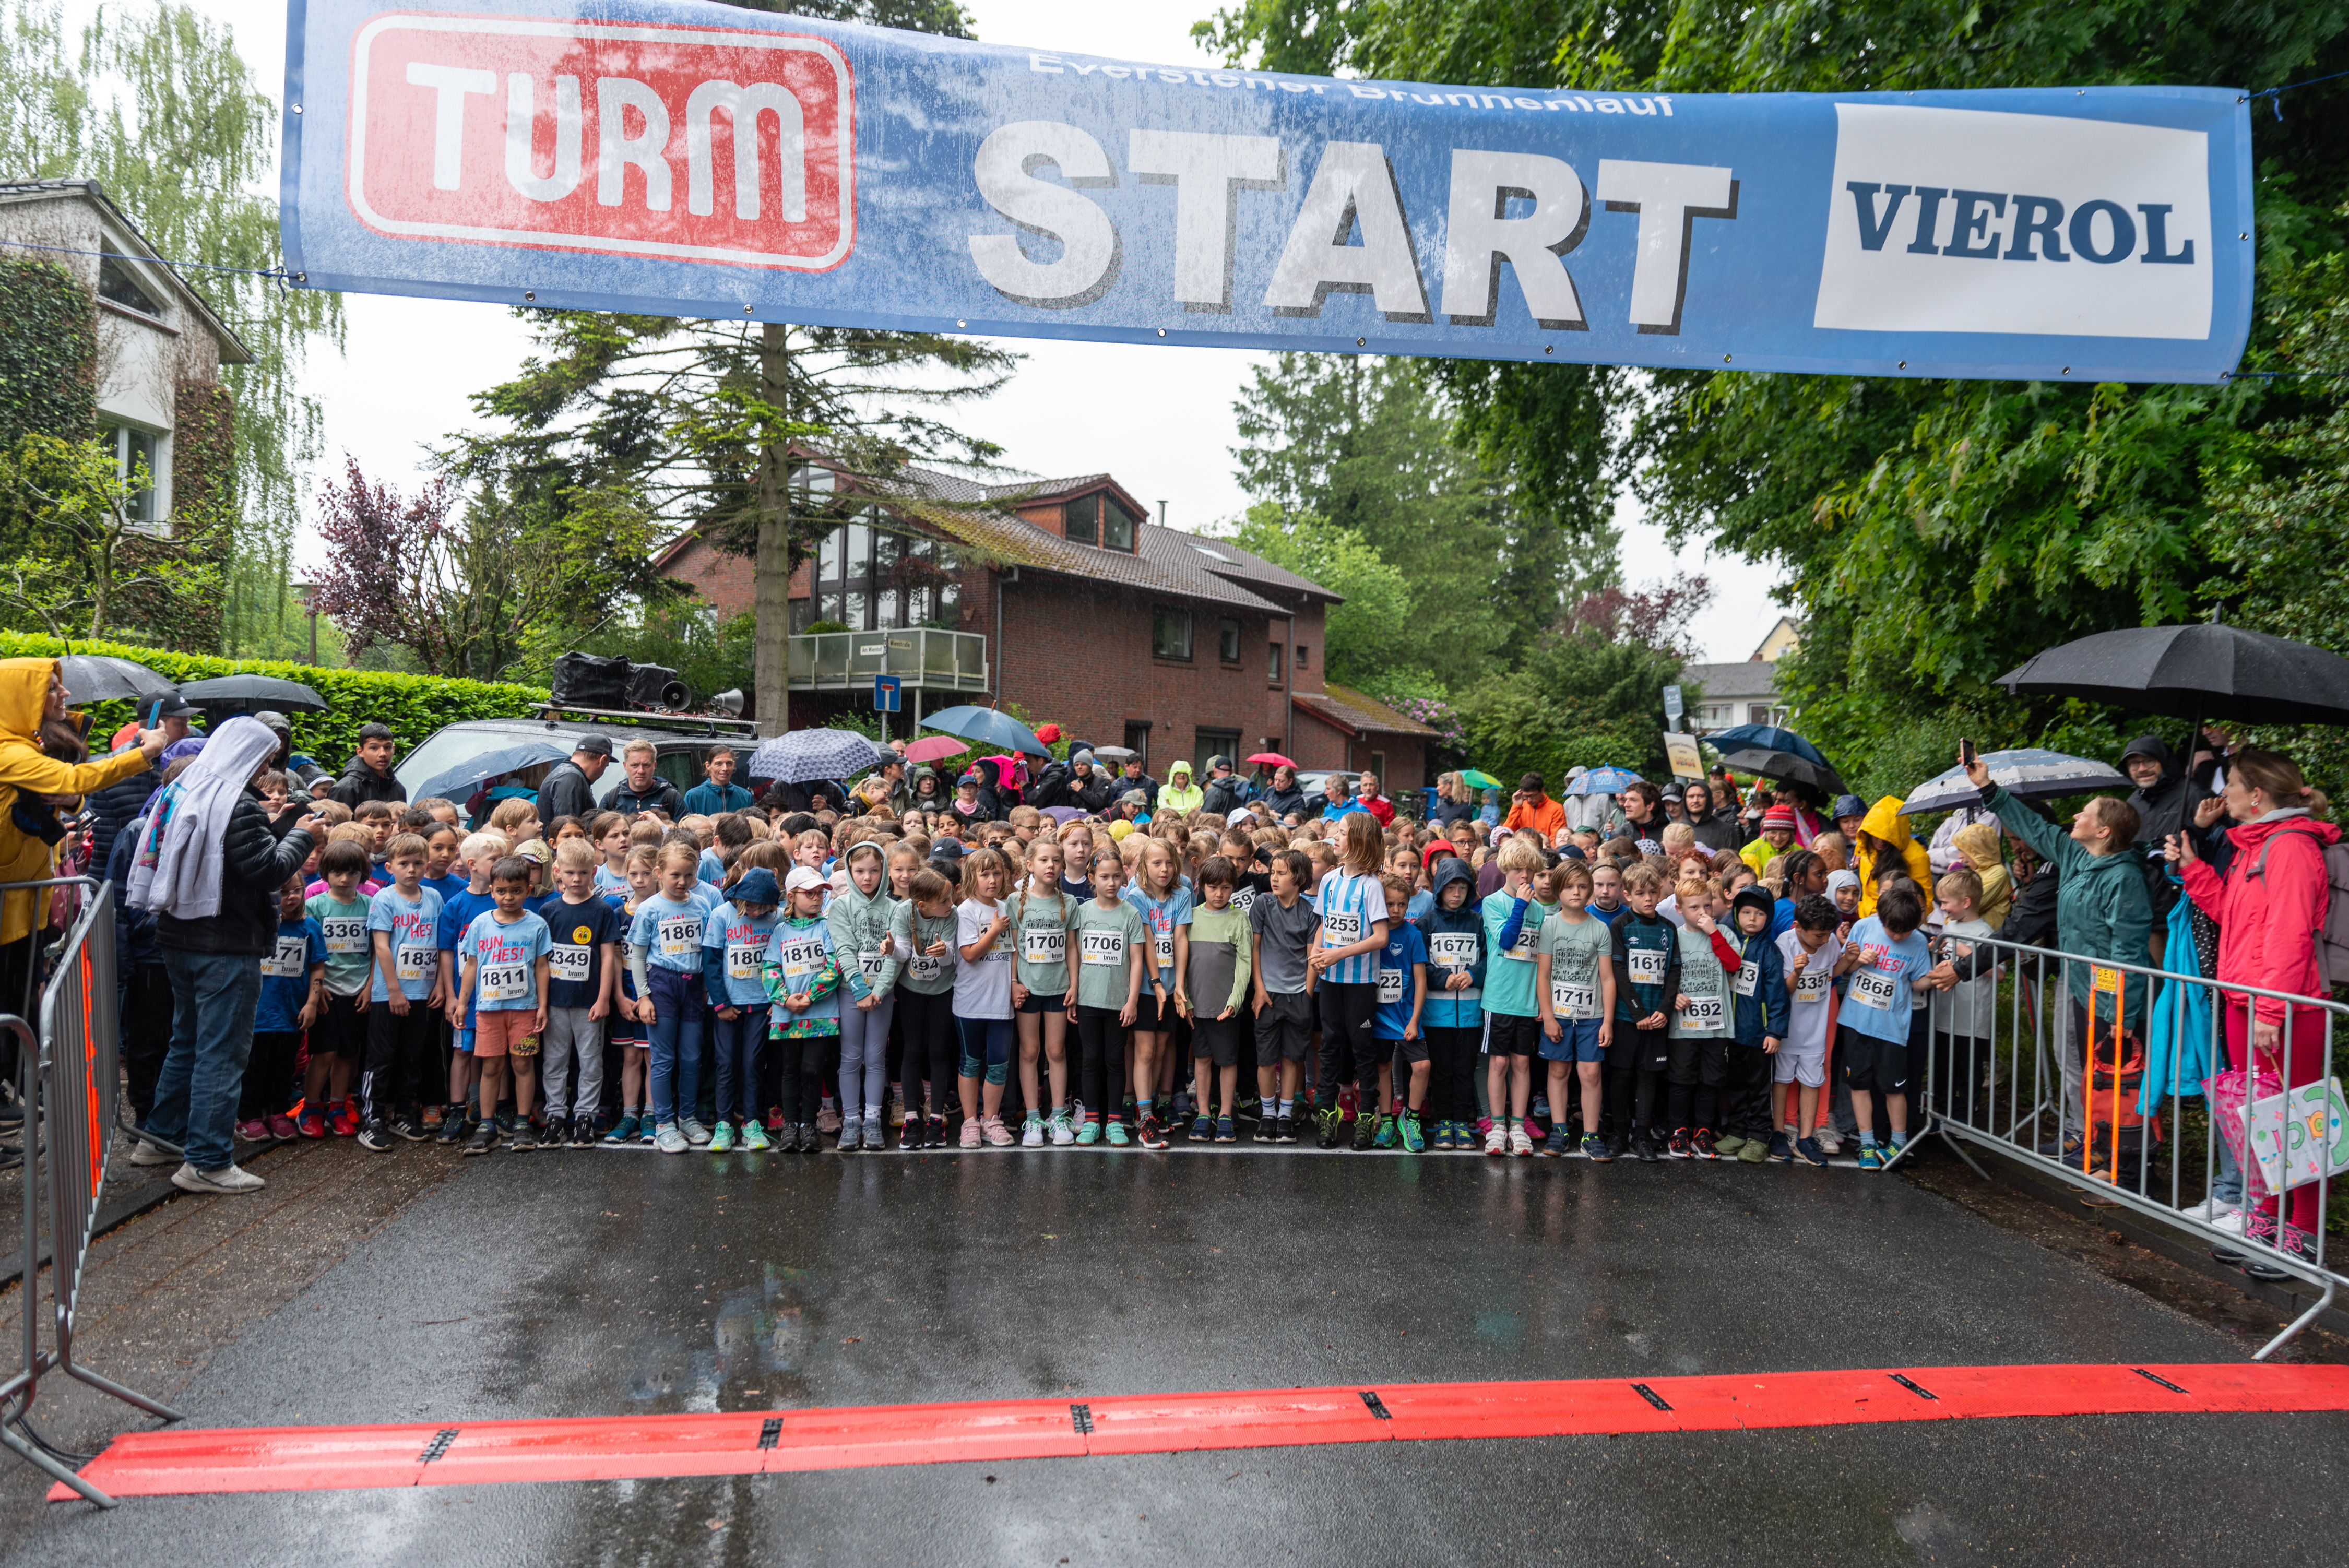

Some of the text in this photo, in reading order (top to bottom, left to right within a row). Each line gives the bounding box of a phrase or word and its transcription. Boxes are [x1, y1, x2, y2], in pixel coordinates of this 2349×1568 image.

[1028, 52, 1674, 117] Everstener Brunnenlauf
[406, 62, 806, 223] TURM
[968, 120, 1739, 335] START
[1846, 181, 2195, 264] VIEROL
[712, 877, 726, 889] RU
[393, 912, 420, 929] RUN
[1325, 916, 1359, 932] 3253
[324, 924, 367, 938] 3361
[661, 924, 701, 941] 1861
[727, 923, 753, 942] RUN
[478, 935, 503, 954] RUN
[666, 944, 684, 953] EWE
[1027, 935, 1064, 949] 1700
[1083, 936, 1121, 951] 1706
[1156, 941, 1173, 954] 18
[1433, 939, 1475, 953] 1677
[1518, 934, 1539, 948] 287
[400, 951, 438, 966] 1834
[492, 947, 525, 963] HES!
[548, 951, 589, 966] 2349
[730, 948, 766, 965] 180
[784, 944, 824, 963] 1816
[787, 966, 803, 975] EWE
[912, 957, 939, 971] 694
[1631, 956, 1667, 970] 1612
[1874, 957, 1905, 972] HES!
[482, 969, 525, 986] 1811
[1380, 976, 1401, 989] 22
[1797, 972, 1829, 990] 3357
[1736, 982, 1750, 992] bruns
[1856, 975, 1894, 997] 1868
[1554, 989, 1592, 1005] 1711
[1852, 991, 1866, 1001] EWE
[1872, 998, 1888, 1007] bruns
[1555, 1006, 1571, 1014] EWE
